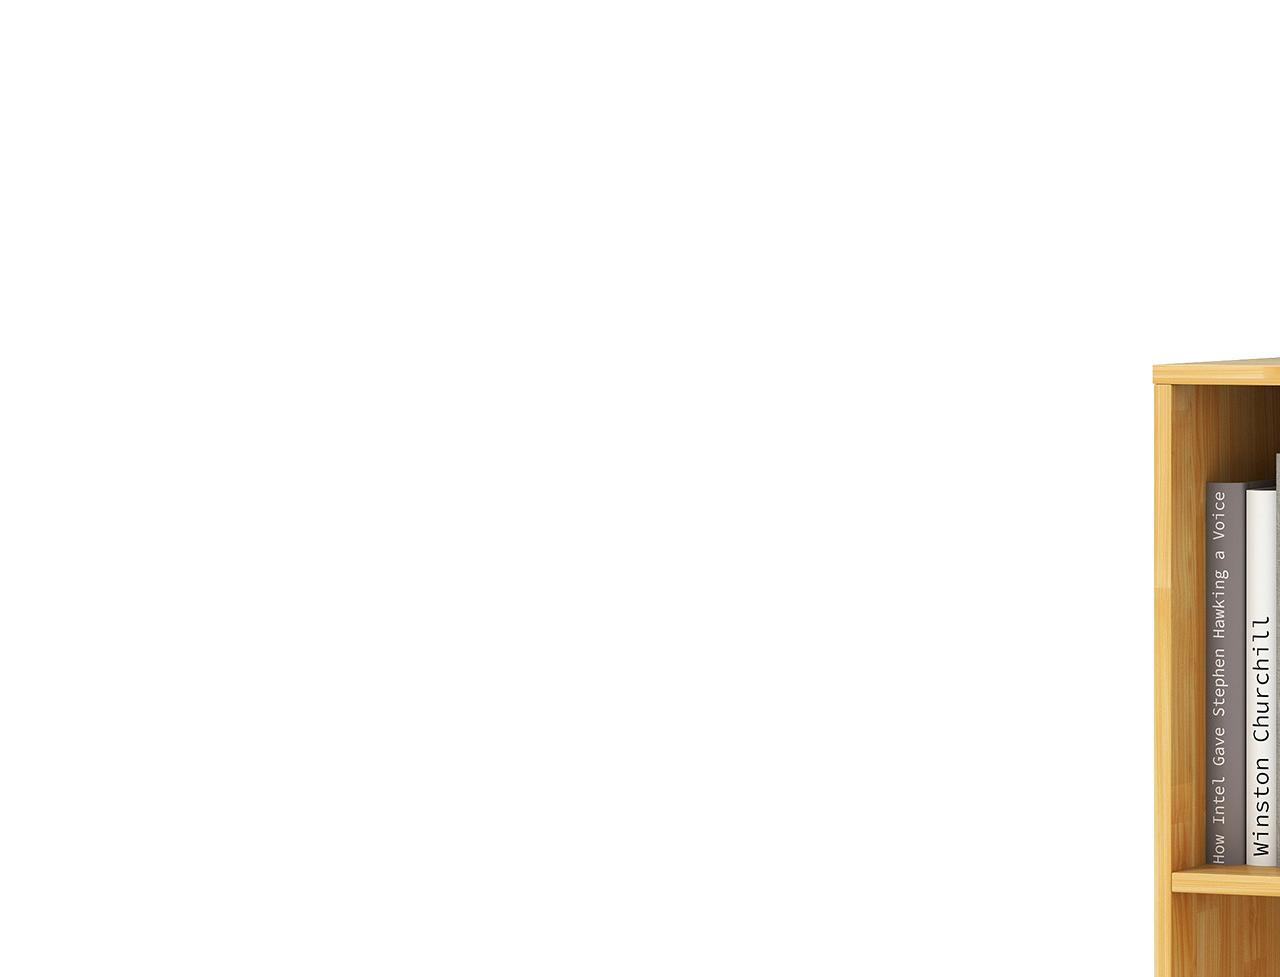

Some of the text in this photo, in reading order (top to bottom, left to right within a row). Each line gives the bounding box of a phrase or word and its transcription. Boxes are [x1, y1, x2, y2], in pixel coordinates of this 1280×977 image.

[1212, 491, 1229, 864] How Intel Gave Stephen Hawking a Voice
[1252, 616, 1270, 857] Winston Churchill
